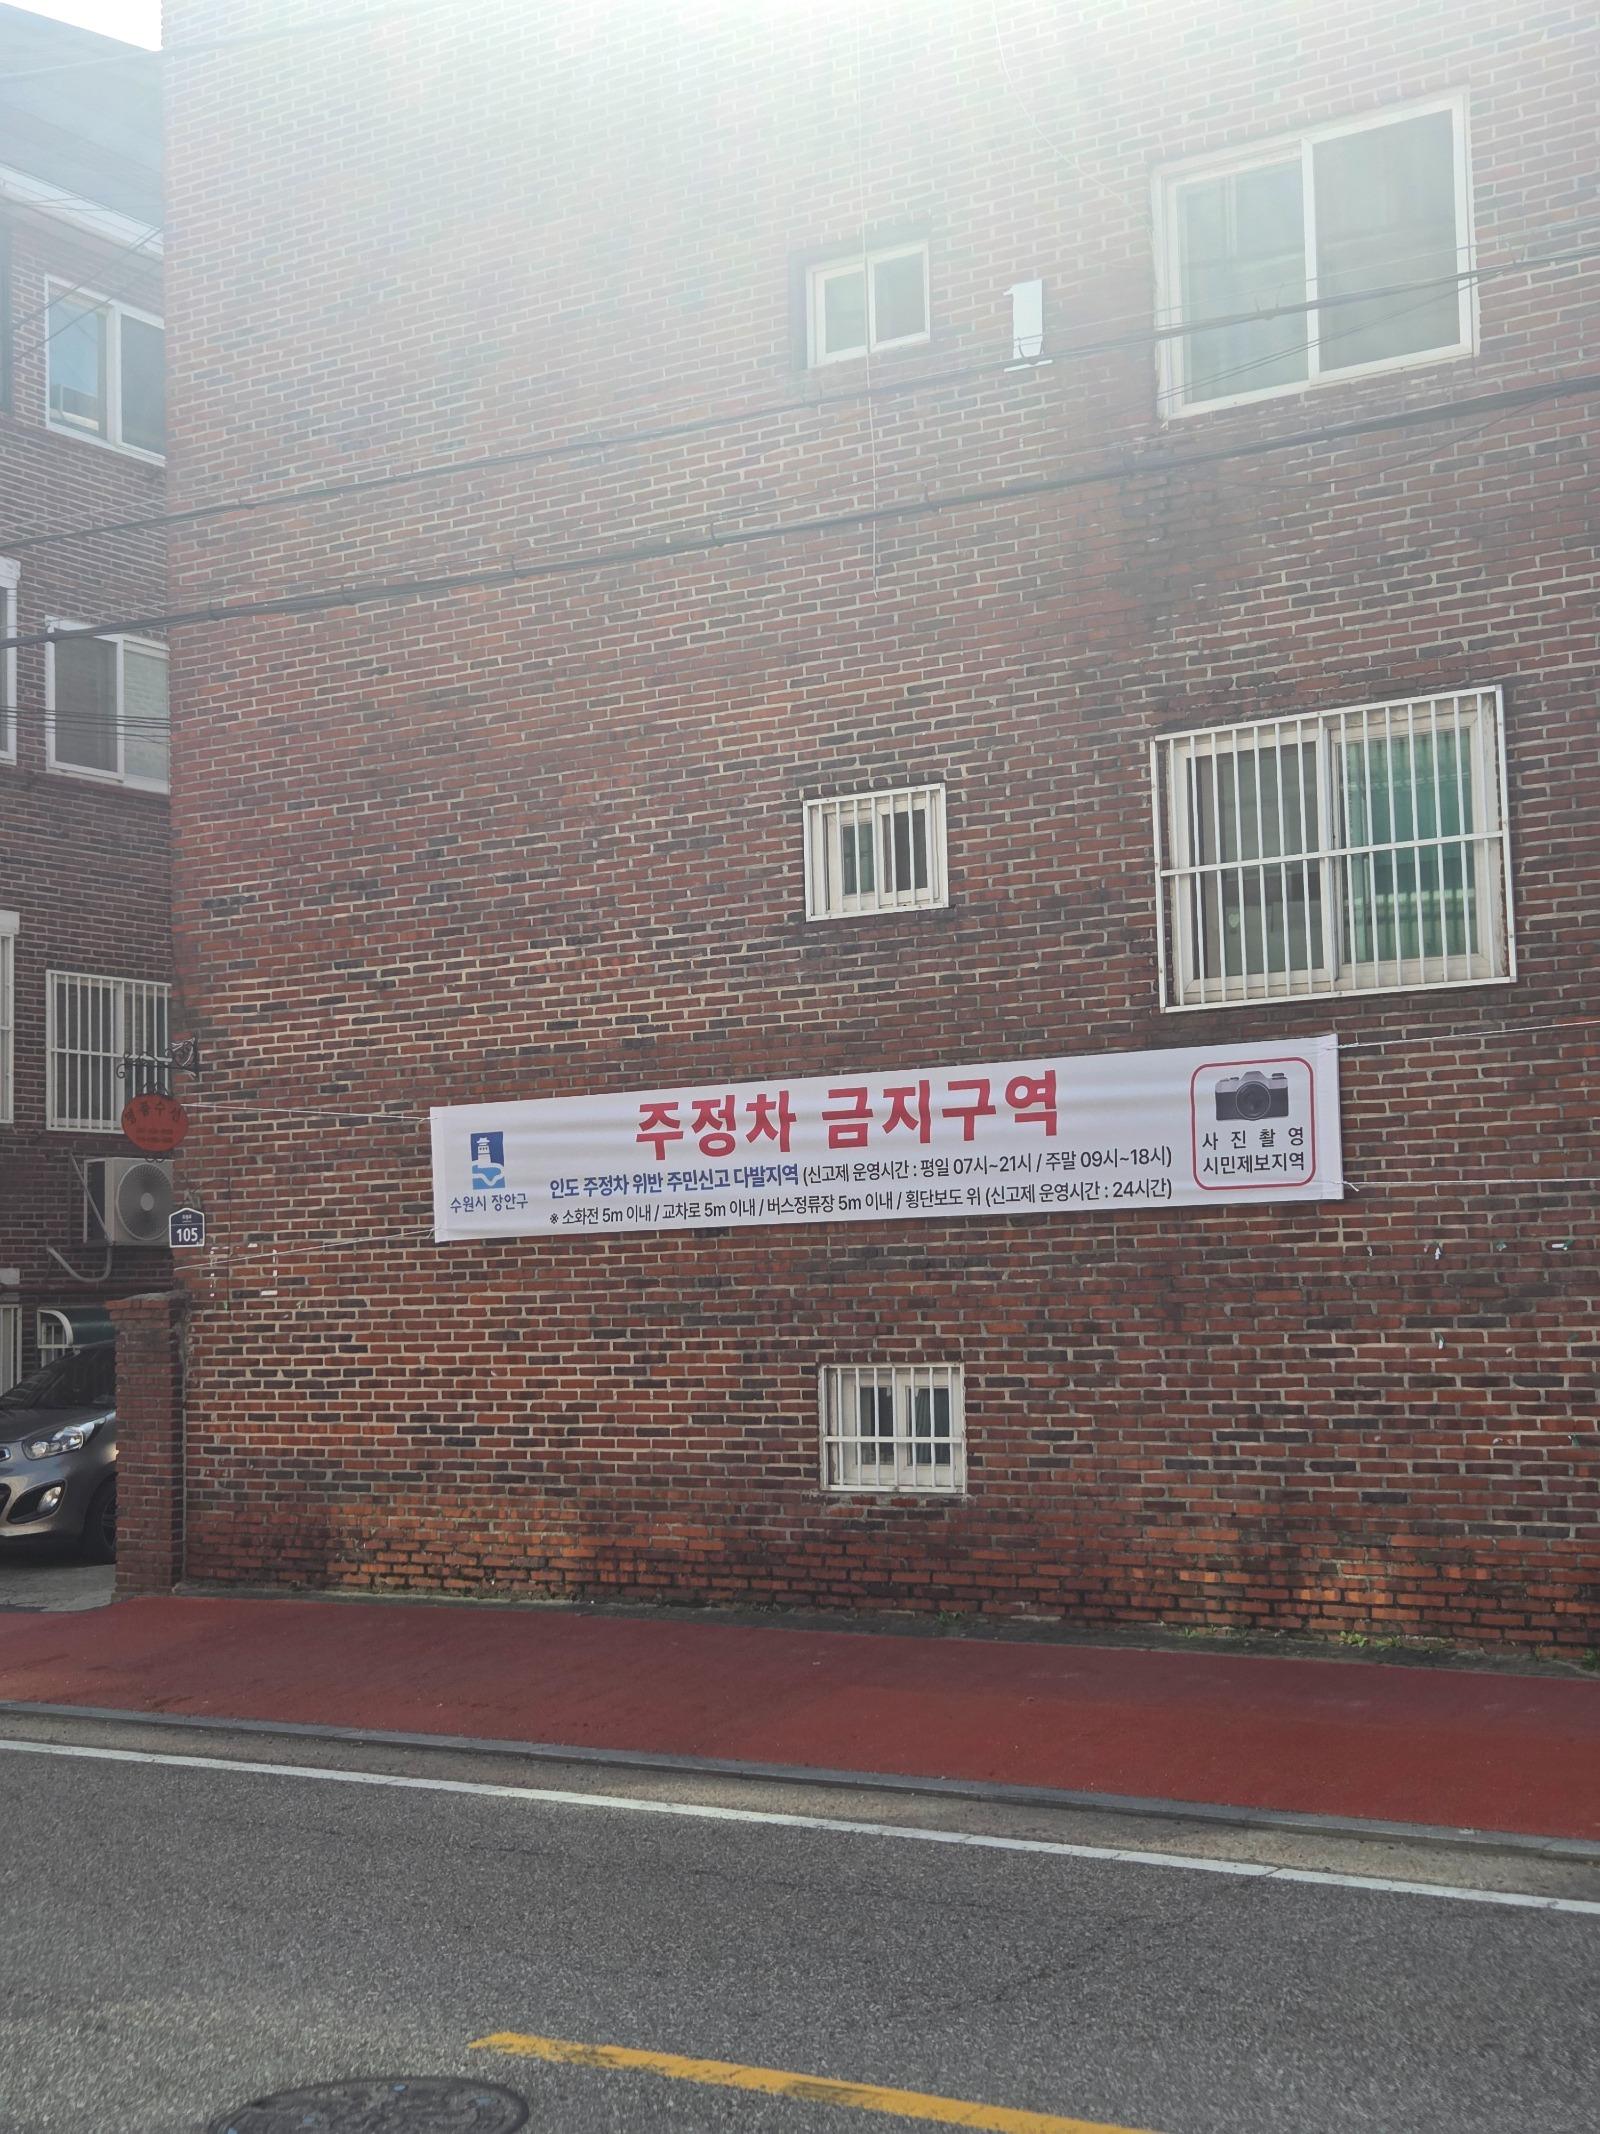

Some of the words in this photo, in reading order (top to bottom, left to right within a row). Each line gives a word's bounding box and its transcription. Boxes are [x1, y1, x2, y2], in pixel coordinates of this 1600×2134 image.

[636, 1090, 797, 1160] 주정차
[822, 1070, 1057, 1149] 금지구역
[550, 1178, 579, 1199] 인도
[583, 1174, 629, 1197] 주정차
[633, 1172, 663, 1194] 위반
[667, 1169, 730, 1192] 주민신고
[733, 1163, 798, 1188] 다발지역
[803, 1163, 849, 1187] (신고제
[853, 1160, 909, 1181] 운영시간
[920, 1158, 949, 1177] 평일
[953, 1153, 1031, 1175] 07시~21시
[1046, 1151, 1076, 1171] 주말
[1081, 1145, 1171, 1168] 09시~18시)
[1203, 1152, 1304, 1175] 시민제보지역
[450, 1195, 486, 1213] 수원시
[492, 1193, 528, 1211] 장안구
[562, 1207, 598, 1225] 소화전
[603, 1208, 623, 1222] 5m
[627, 1204, 651, 1223] 이내
[662, 1202, 701, 1220] 교차로
[705, 1202, 726, 1217] 5m
[730, 1198, 755, 1217] 이내
[767, 1194, 835, 1215] 버스정류장
[839, 1195, 861, 1210] 5m
[865, 1191, 892, 1210] 이내
[906, 1189, 963, 1208] 횡단보도
[966, 1187, 980, 1206] 위
[986, 1184, 1035, 1207] (신고제
[1039, 1181, 1100, 1202] 운영시간
[1113, 1178, 1172, 1199] 24시간)
[176, 1227, 198, 1242] 105
